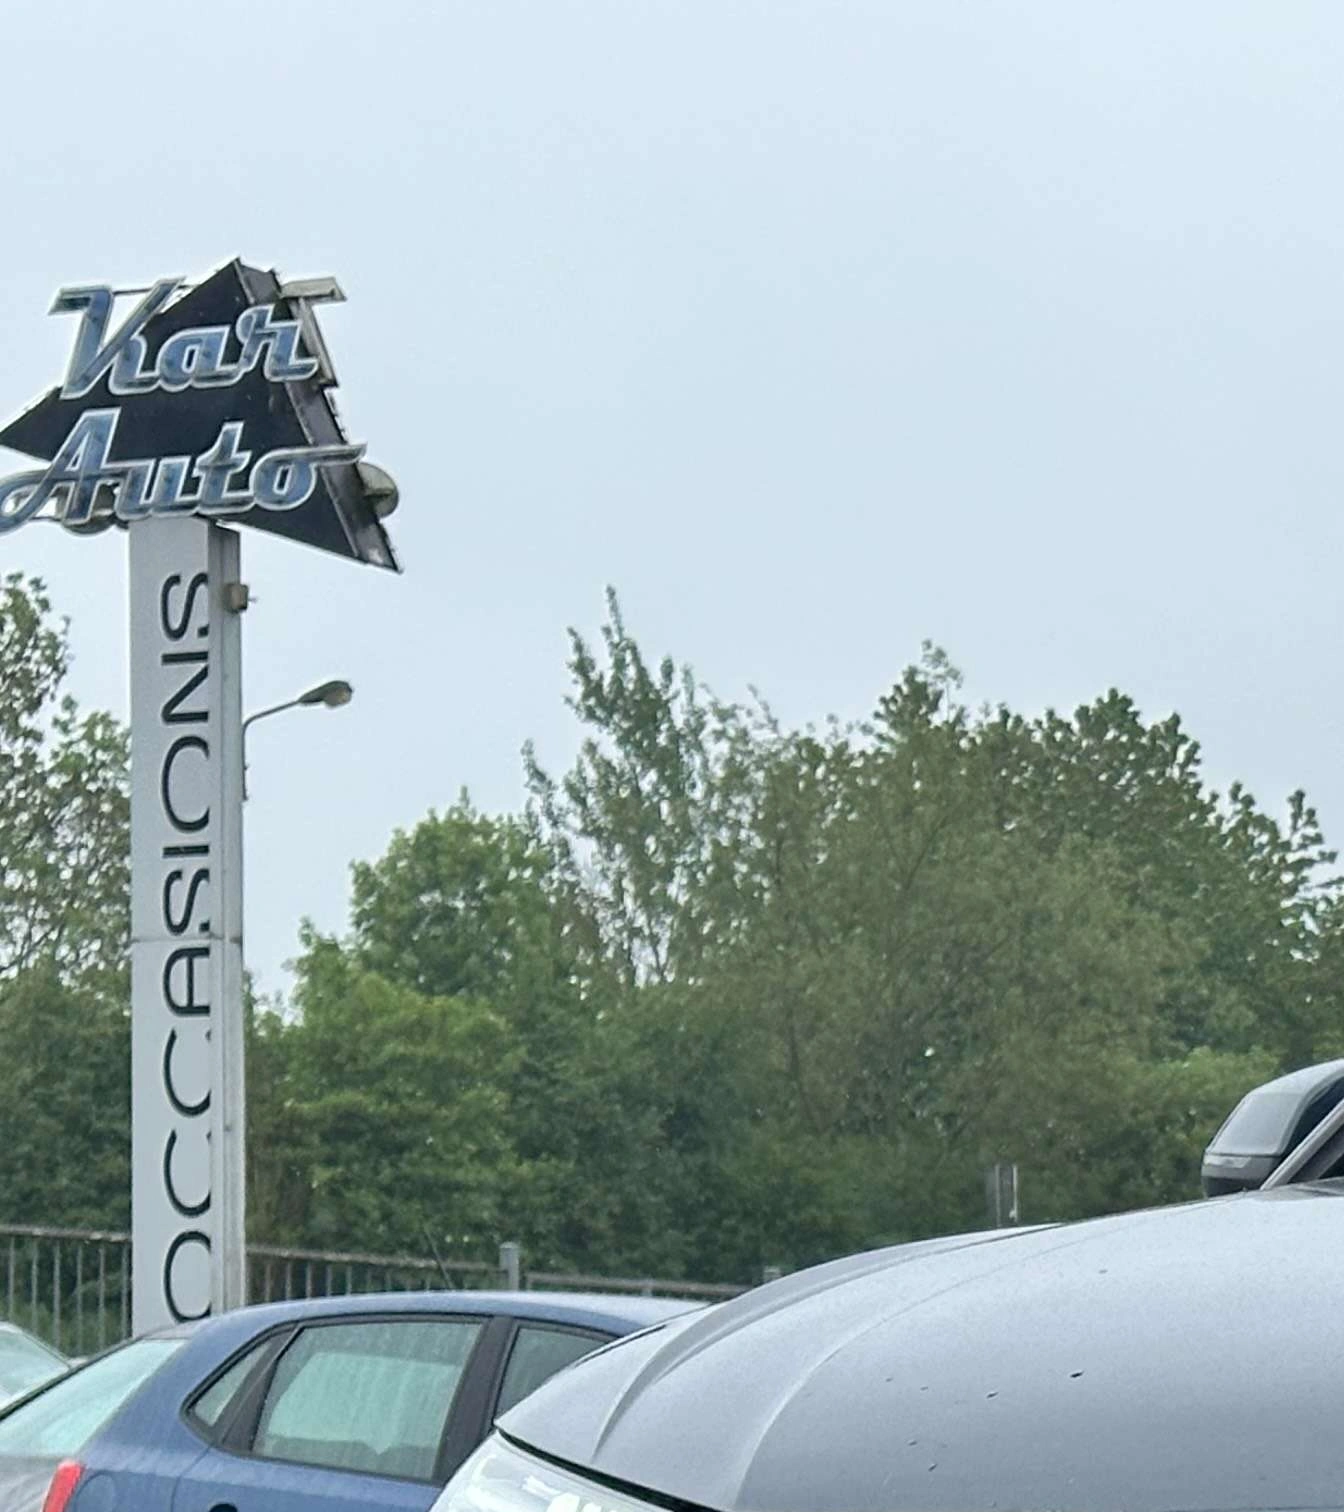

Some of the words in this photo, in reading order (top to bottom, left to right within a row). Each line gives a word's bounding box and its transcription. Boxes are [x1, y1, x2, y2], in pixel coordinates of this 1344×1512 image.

[48, 275, 320, 400] Kar
[0, 406, 368, 536] Auto
[160, 570, 212, 1324] OCCASIONS
